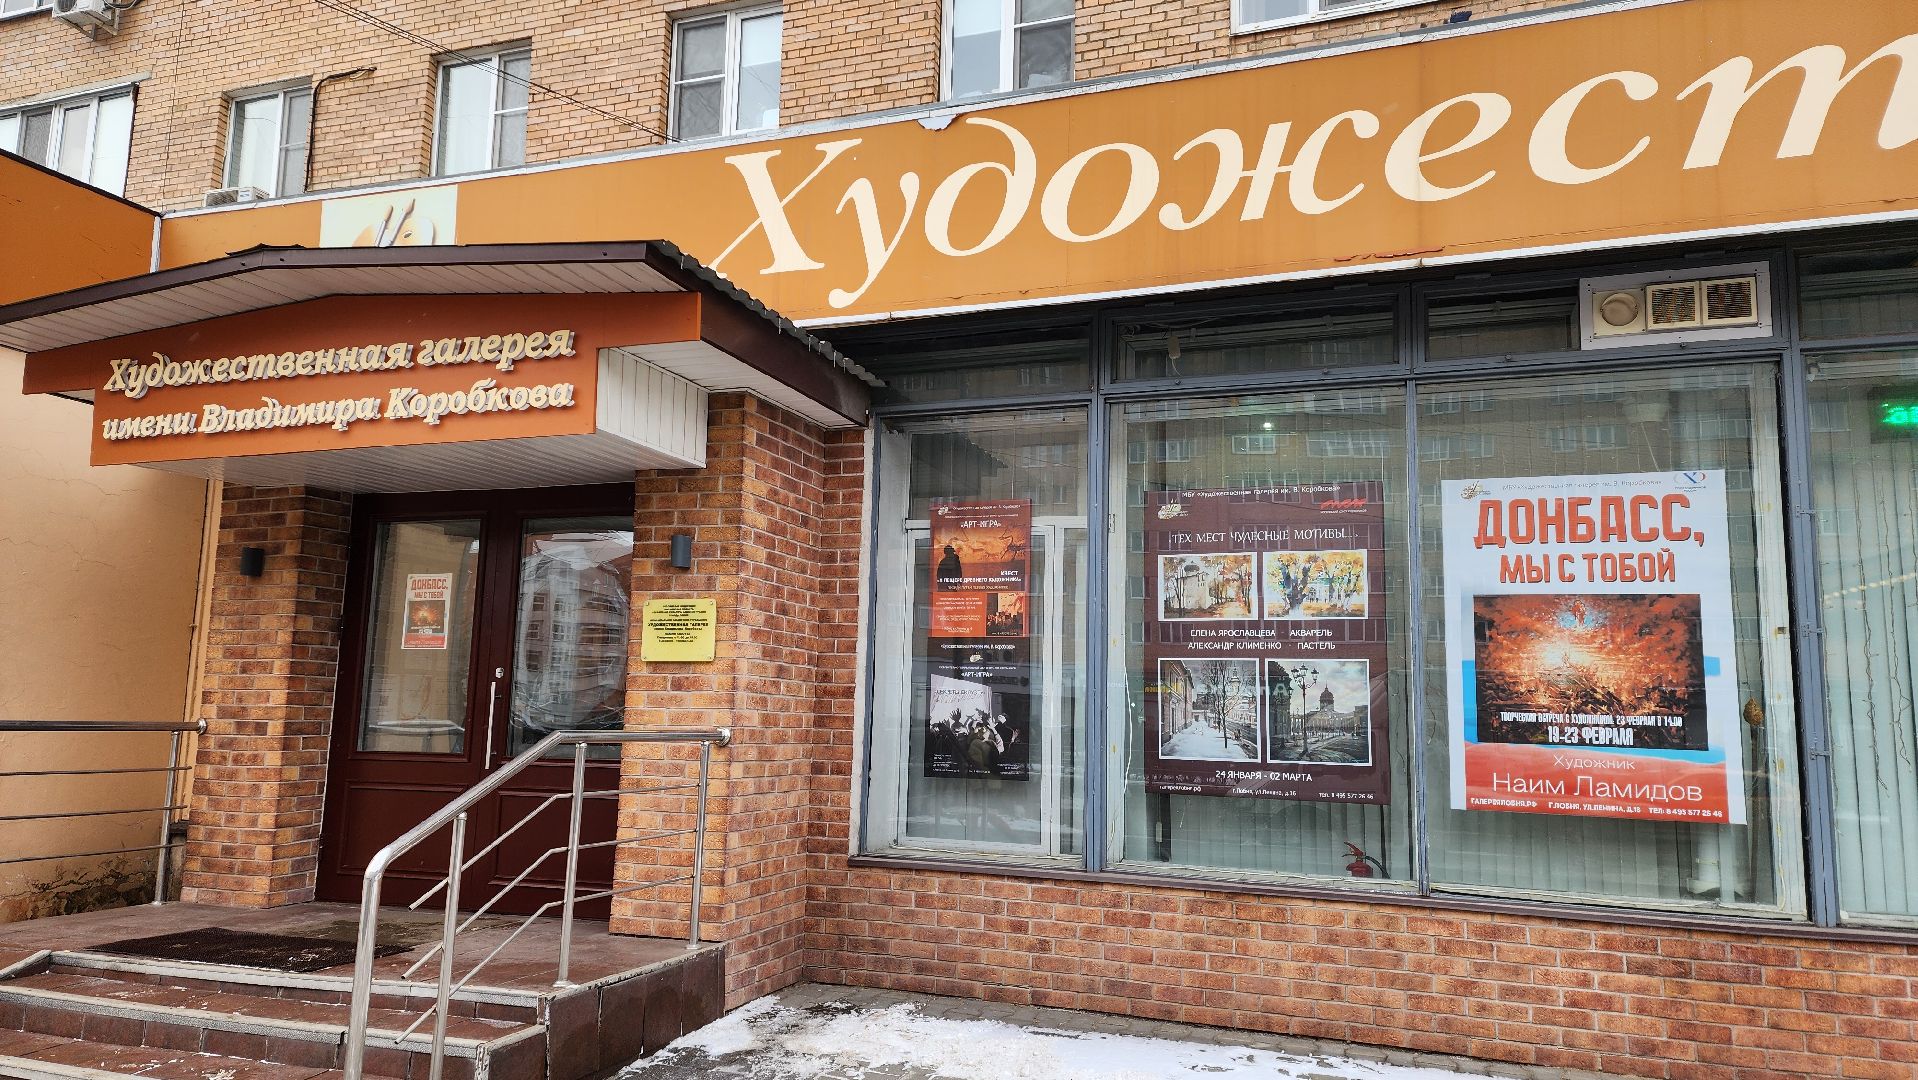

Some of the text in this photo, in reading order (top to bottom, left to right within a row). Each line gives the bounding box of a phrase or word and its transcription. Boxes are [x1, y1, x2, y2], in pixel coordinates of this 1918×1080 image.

[701, 33, 1918, 309] Художест
[103, 329, 576, 399] Художественная галерея
[102, 378, 575, 440] имени Владимира Коробкова
[960, 520, 1002, 529] «АРТ-ИГРА»
[1473, 493, 1705, 549] ДОНБАСС,
[1196, 532, 1226, 543] МЕСТ
[1230, 530, 1289, 543] ЧУДЕСНЫЕ
[1499, 548, 1676, 584] МЫ С ТОБОЙ
[411, 579, 448, 590] ДОНБАСС,
[1190, 629, 1217, 637] ЕЛЕНА
[1218, 629, 1276, 638] ЯРОСЛАВЦЕВА
[1290, 629, 1333, 637] АКВАРЕЛЬ
[1187, 641, 1235, 650] АЛЕКСАНДР
[1236, 641, 1282, 650] КЛИМЕНКО
[1297, 641, 1336, 650] ПАСТЕЛЬ
[1500, 711, 1537, 723] ТВОРЧЕСКАЯ
[1538, 712, 1564, 724] ВСТРЕЧА
[1616, 715, 1626, 726] 23
[1628, 715, 1657, 727] ФЕВРАЛЯ
[1657, 715, 1662, 727] В
[1548, 725, 1634, 746] 19-23 ФЕВРАЛЯ
[1553, 754, 1636, 770] Художник
[1215, 770, 1226, 778] 24
[1227, 770, 1262, 780] ЯНВАРЯ
[1269, 772, 1280, 781] 02
[1282, 772, 1313, 782] МАРТА
[1493, 772, 1703, 803] Наим Ламидов
